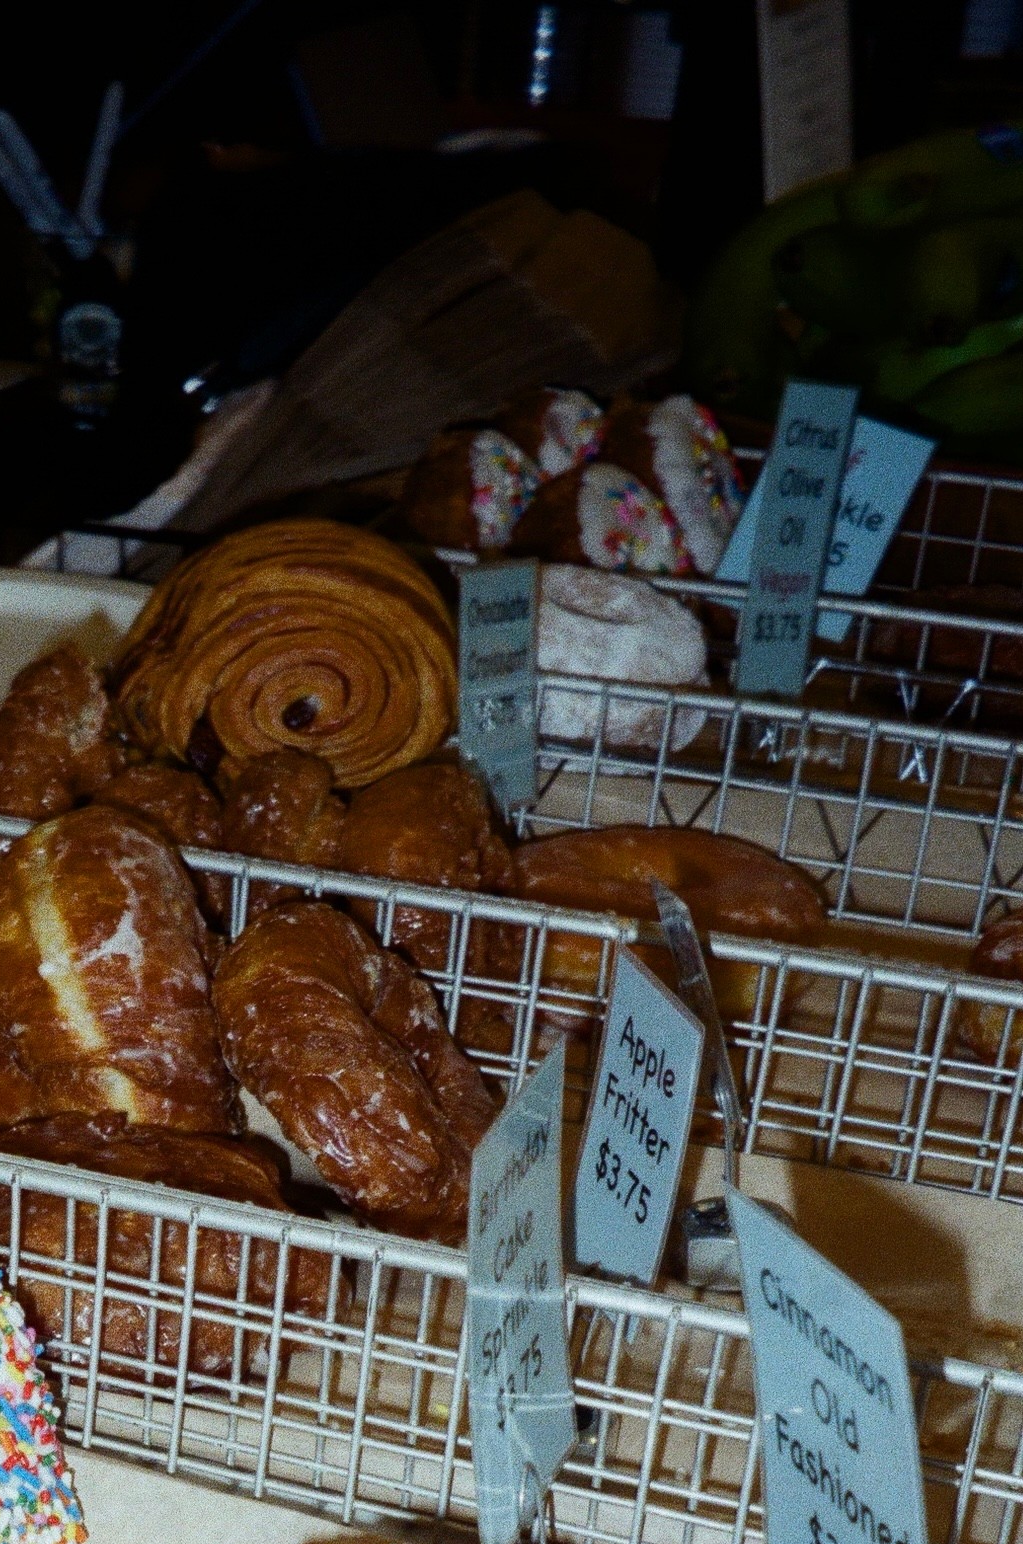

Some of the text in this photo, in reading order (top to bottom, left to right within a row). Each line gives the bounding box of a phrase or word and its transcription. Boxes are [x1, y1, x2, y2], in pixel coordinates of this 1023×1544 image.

[785, 417, 841, 450] Citrus
[779, 468, 825, 498] Olive
[779, 517, 805, 547] Oil
[620, 1015, 675, 1099] Apple
[603, 1071, 671, 1165] Fritter
[477, 1112, 550, 1236] Birthday
[595, 1137, 652, 1225] $3.75
[493, 1209, 533, 1283] Cake
[759, 1267, 893, 1413] Cinnamon
[810, 1377, 859, 1453] Old
